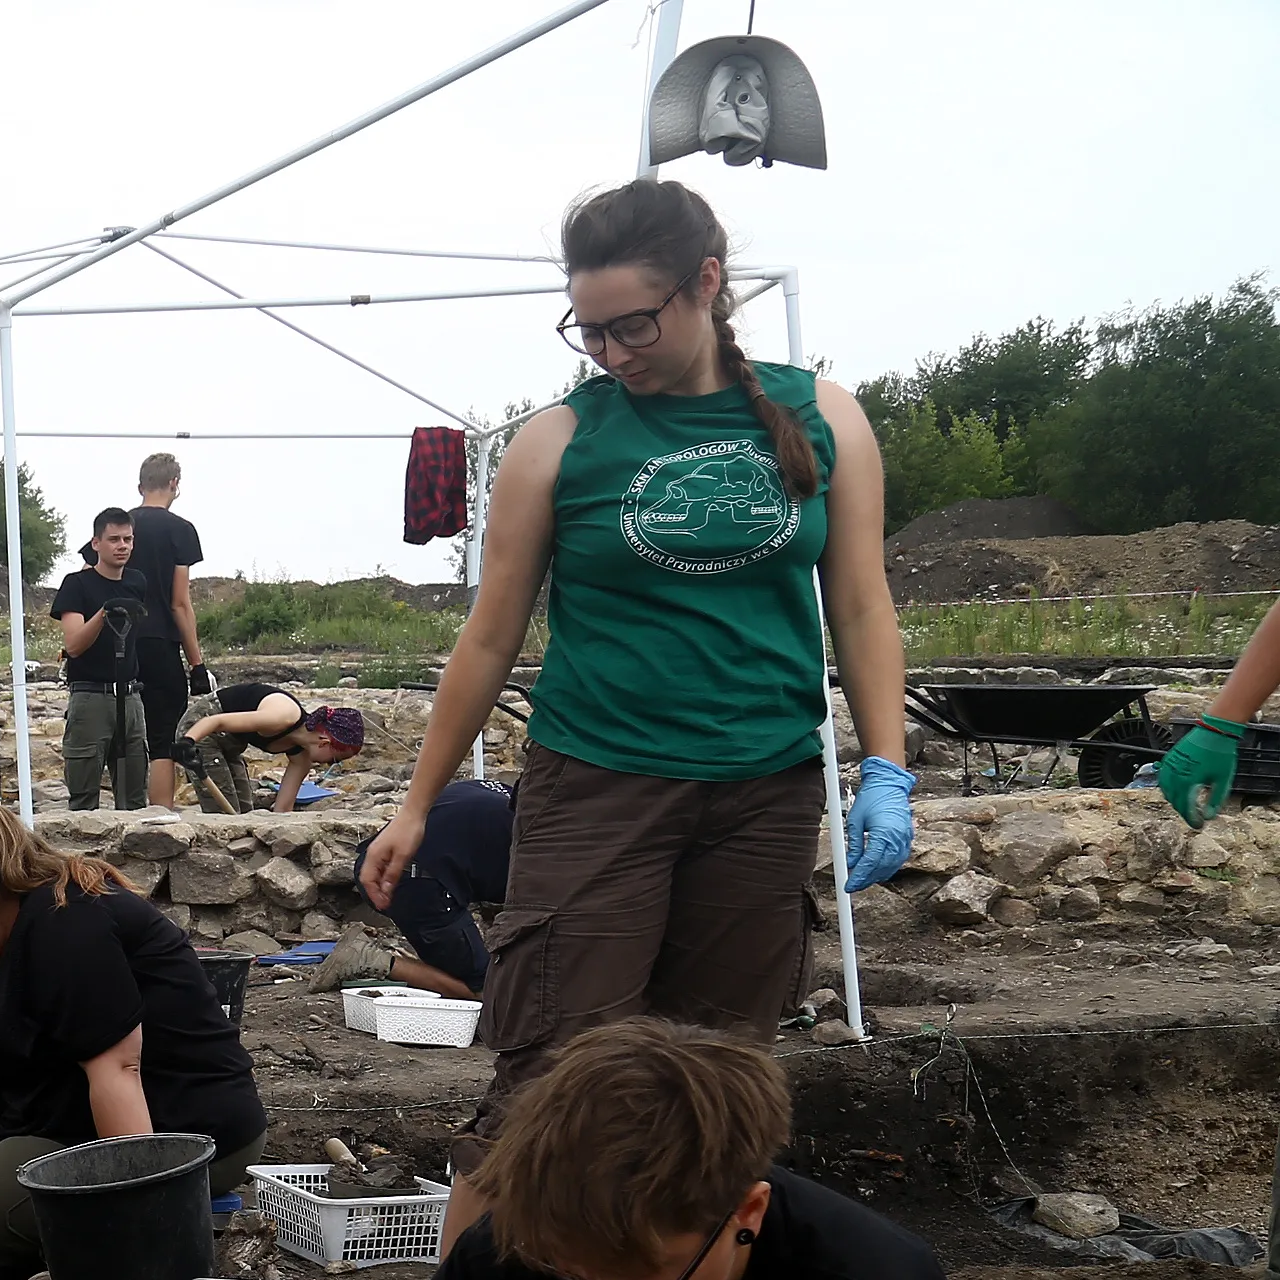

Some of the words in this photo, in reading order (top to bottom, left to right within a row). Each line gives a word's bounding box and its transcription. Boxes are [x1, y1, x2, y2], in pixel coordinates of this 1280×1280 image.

[631, 472, 650, 493] SKN
[647, 441, 739, 474] ANOPOLOGÓW
[623, 512, 665, 564] Uniwersytet
[666, 556, 747, 573] Przyrodniczy
[751, 547, 769, 560] we
